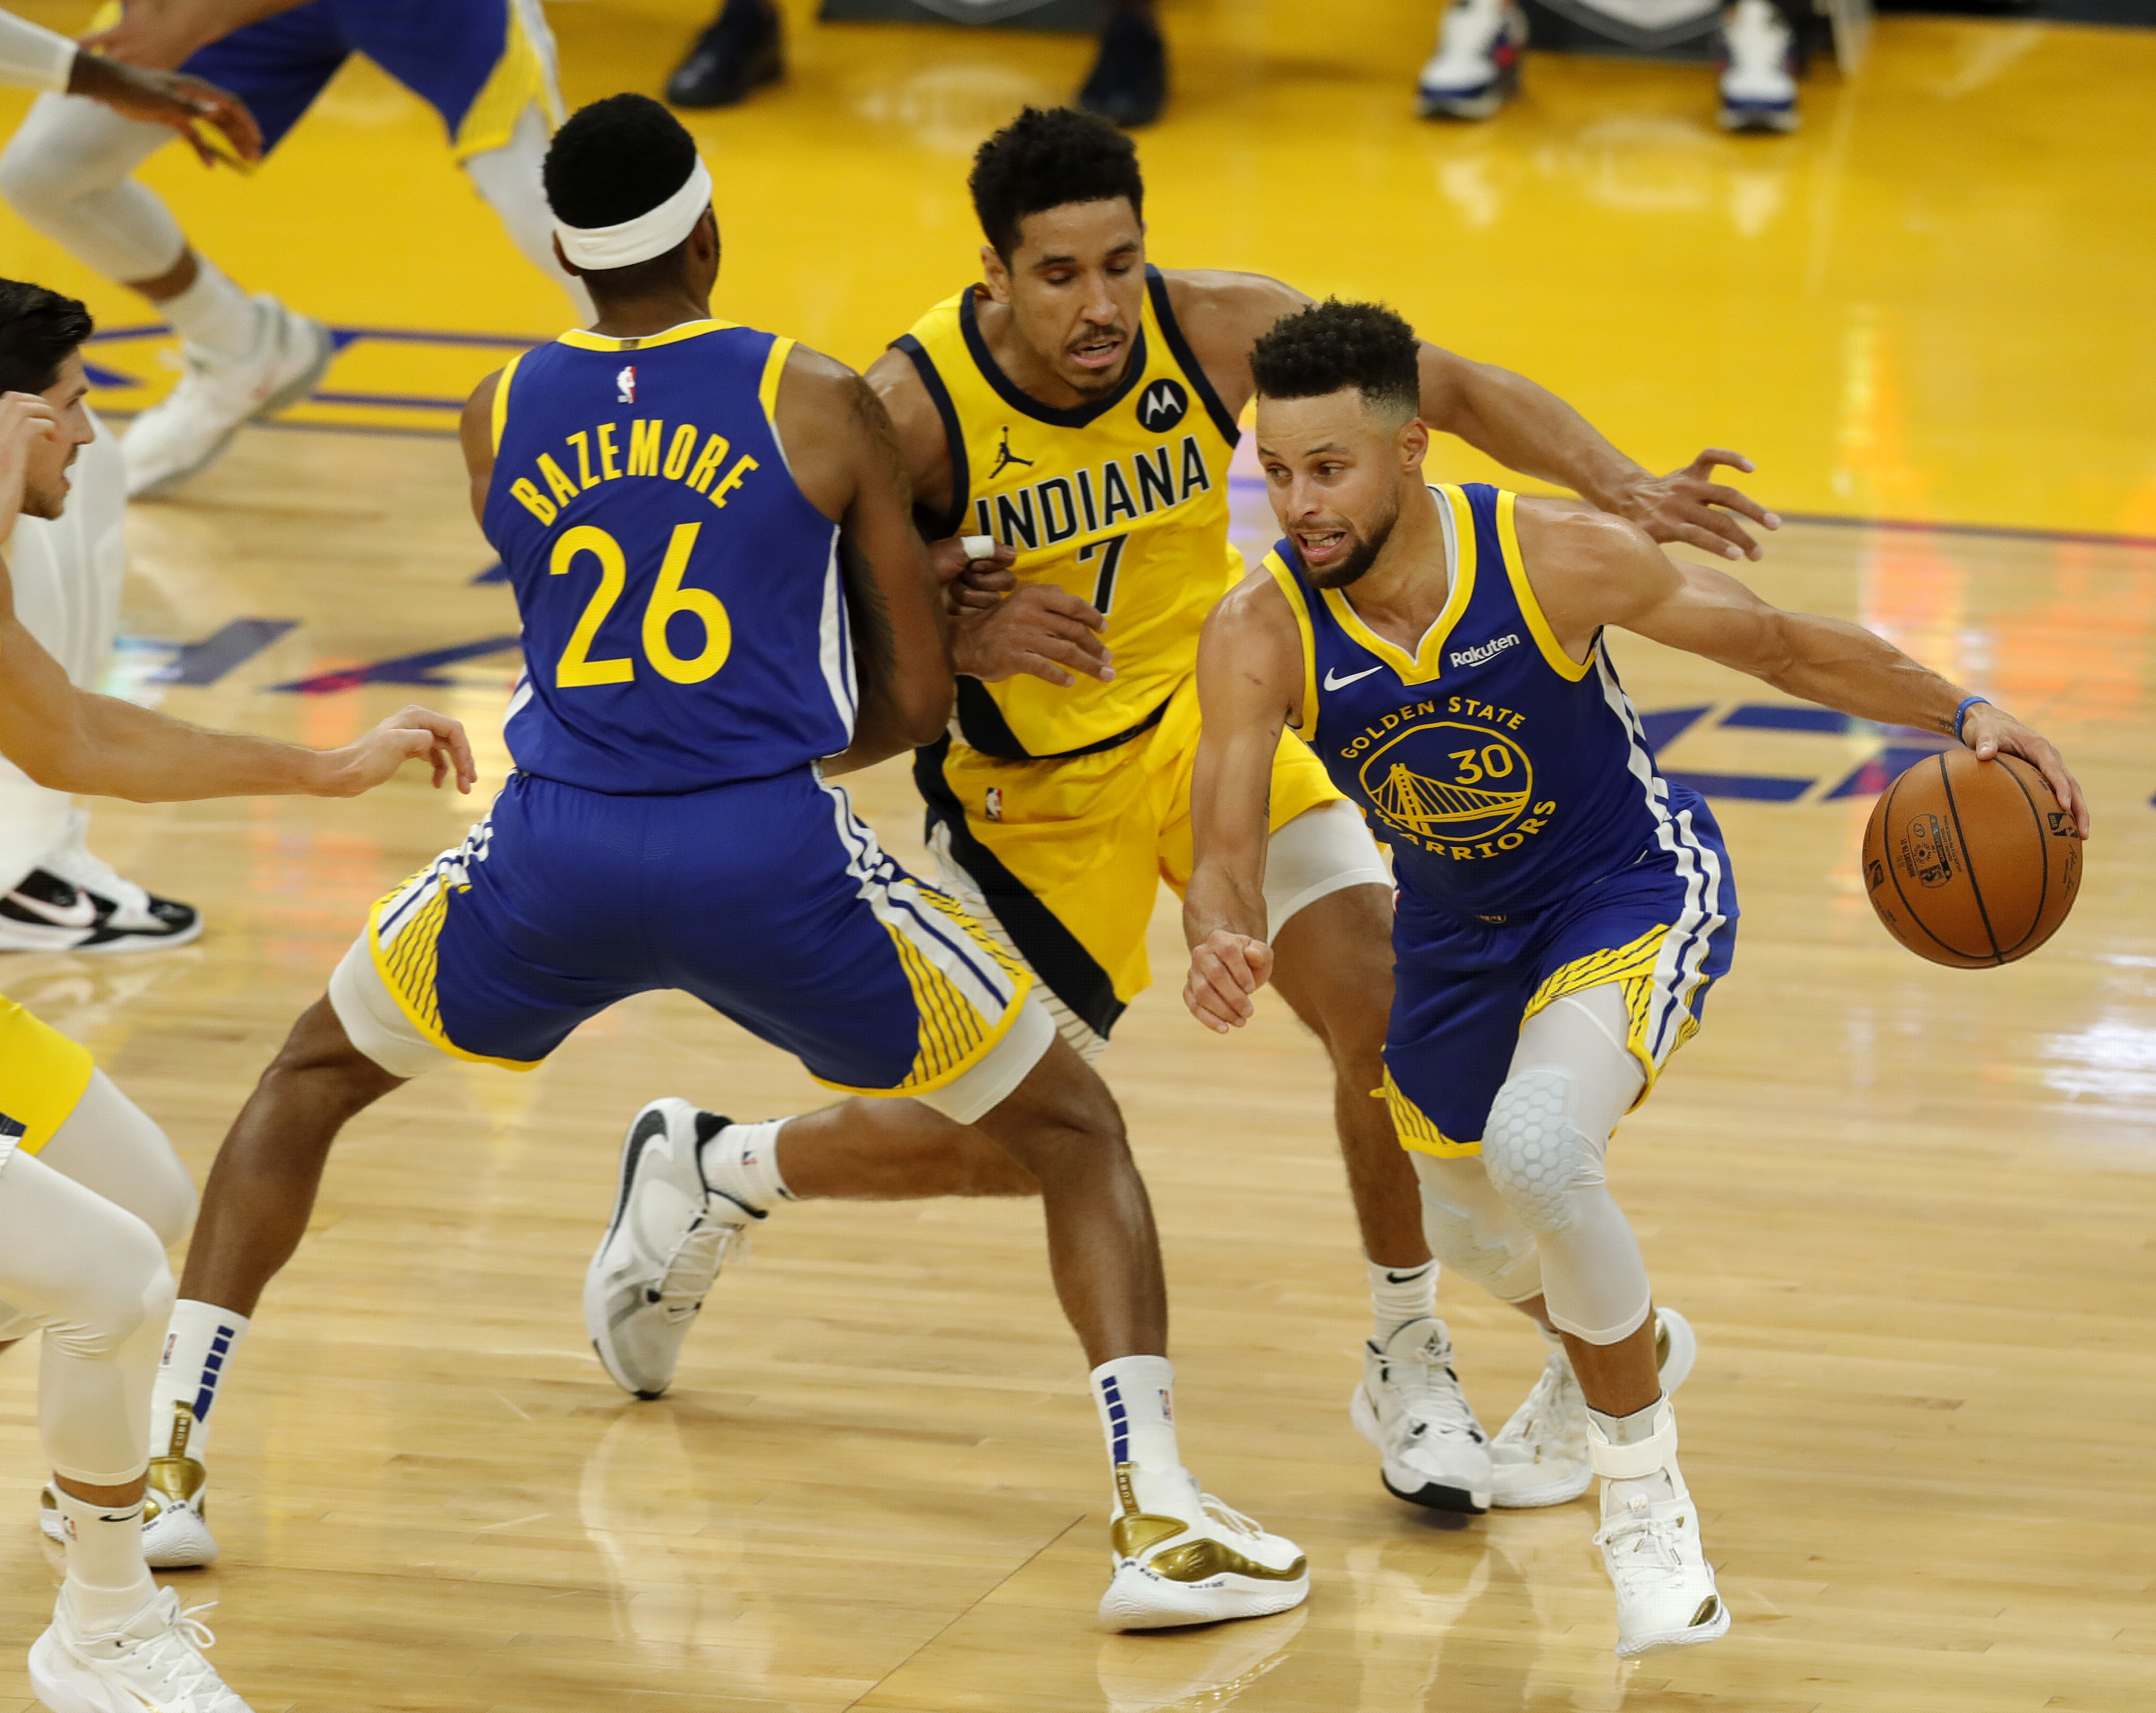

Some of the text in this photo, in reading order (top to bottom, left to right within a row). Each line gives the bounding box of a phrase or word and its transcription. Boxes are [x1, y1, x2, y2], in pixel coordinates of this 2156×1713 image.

[510, 419, 760, 527] BAZEMORE
[974, 434, 1211, 551] INDIANA
[549, 522, 732, 688] 26
[1077, 532, 1131, 616] 7
[1449, 633, 1520, 668] Rakuten
[1341, 696, 1526, 759] GOLDEN STATE
[1448, 744, 1514, 784] 30
[1375, 800, 1556, 860] WARRIORS
[2048, 815, 2059, 827] NBA
